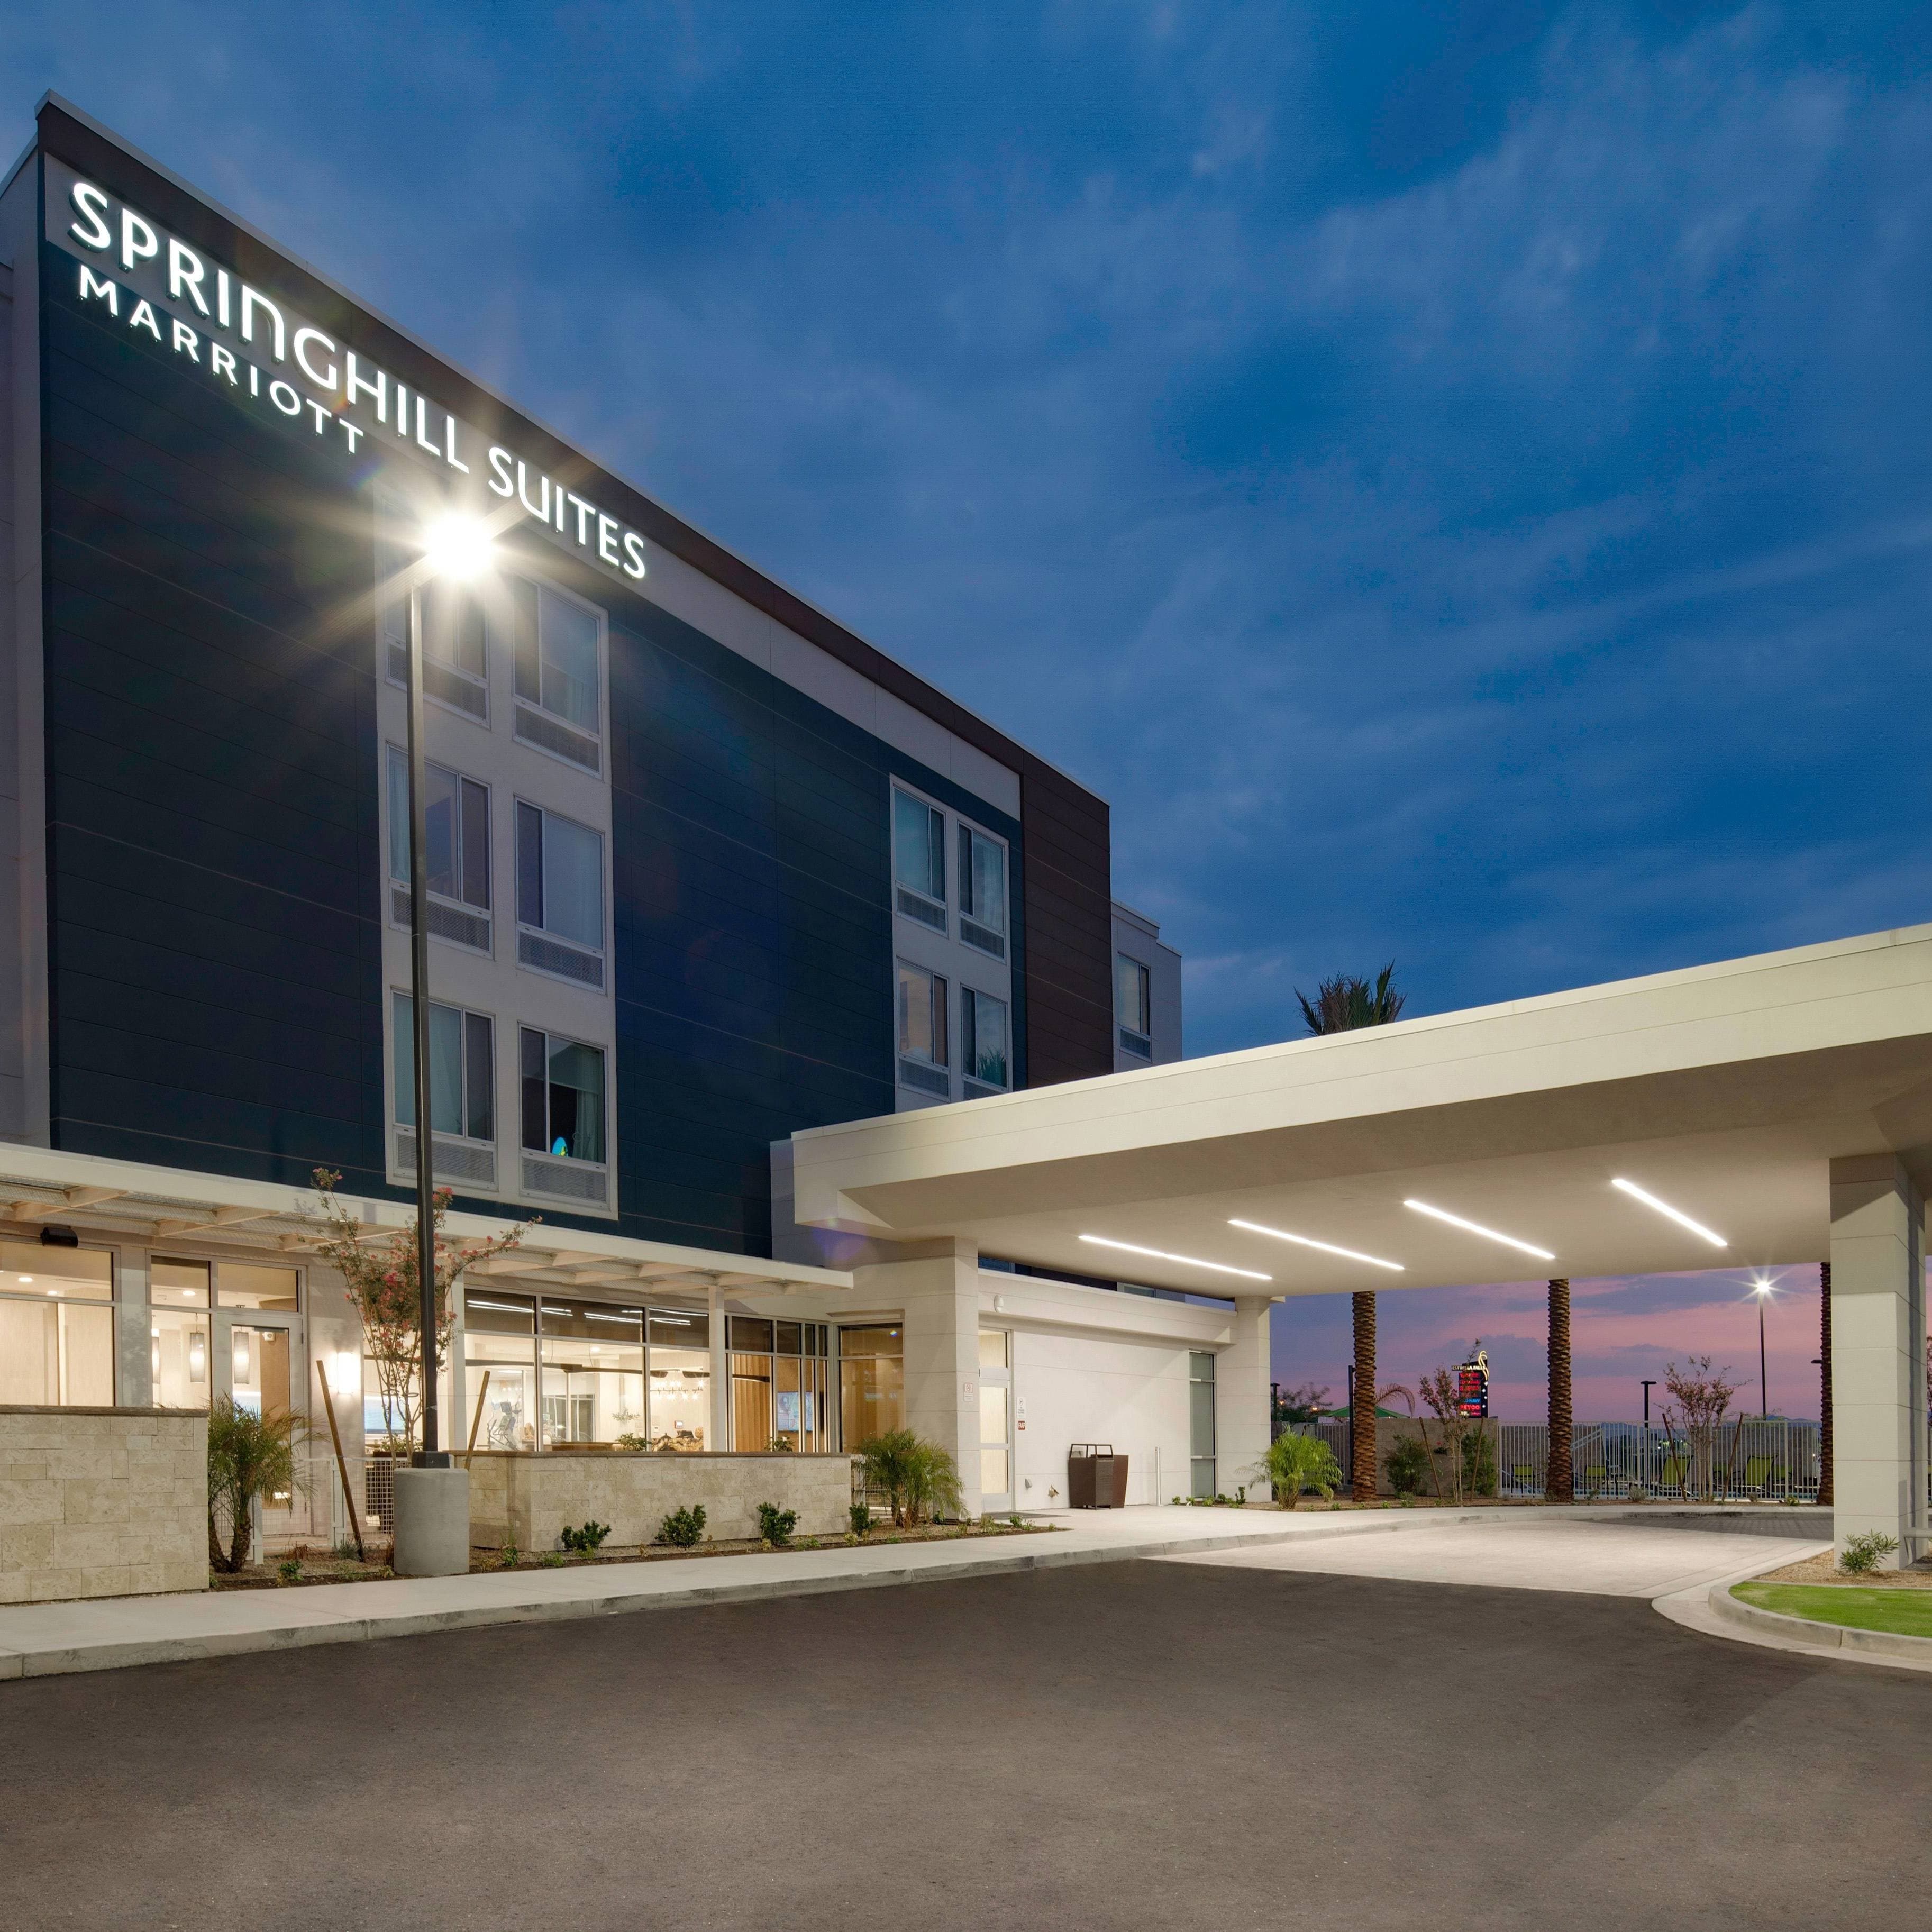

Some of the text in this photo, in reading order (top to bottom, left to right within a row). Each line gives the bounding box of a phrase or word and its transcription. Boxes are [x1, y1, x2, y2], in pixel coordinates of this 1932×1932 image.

[71, 183, 645, 579] SPRINGHILL SUITES
[80, 265, 364, 454] MARRIOTT
